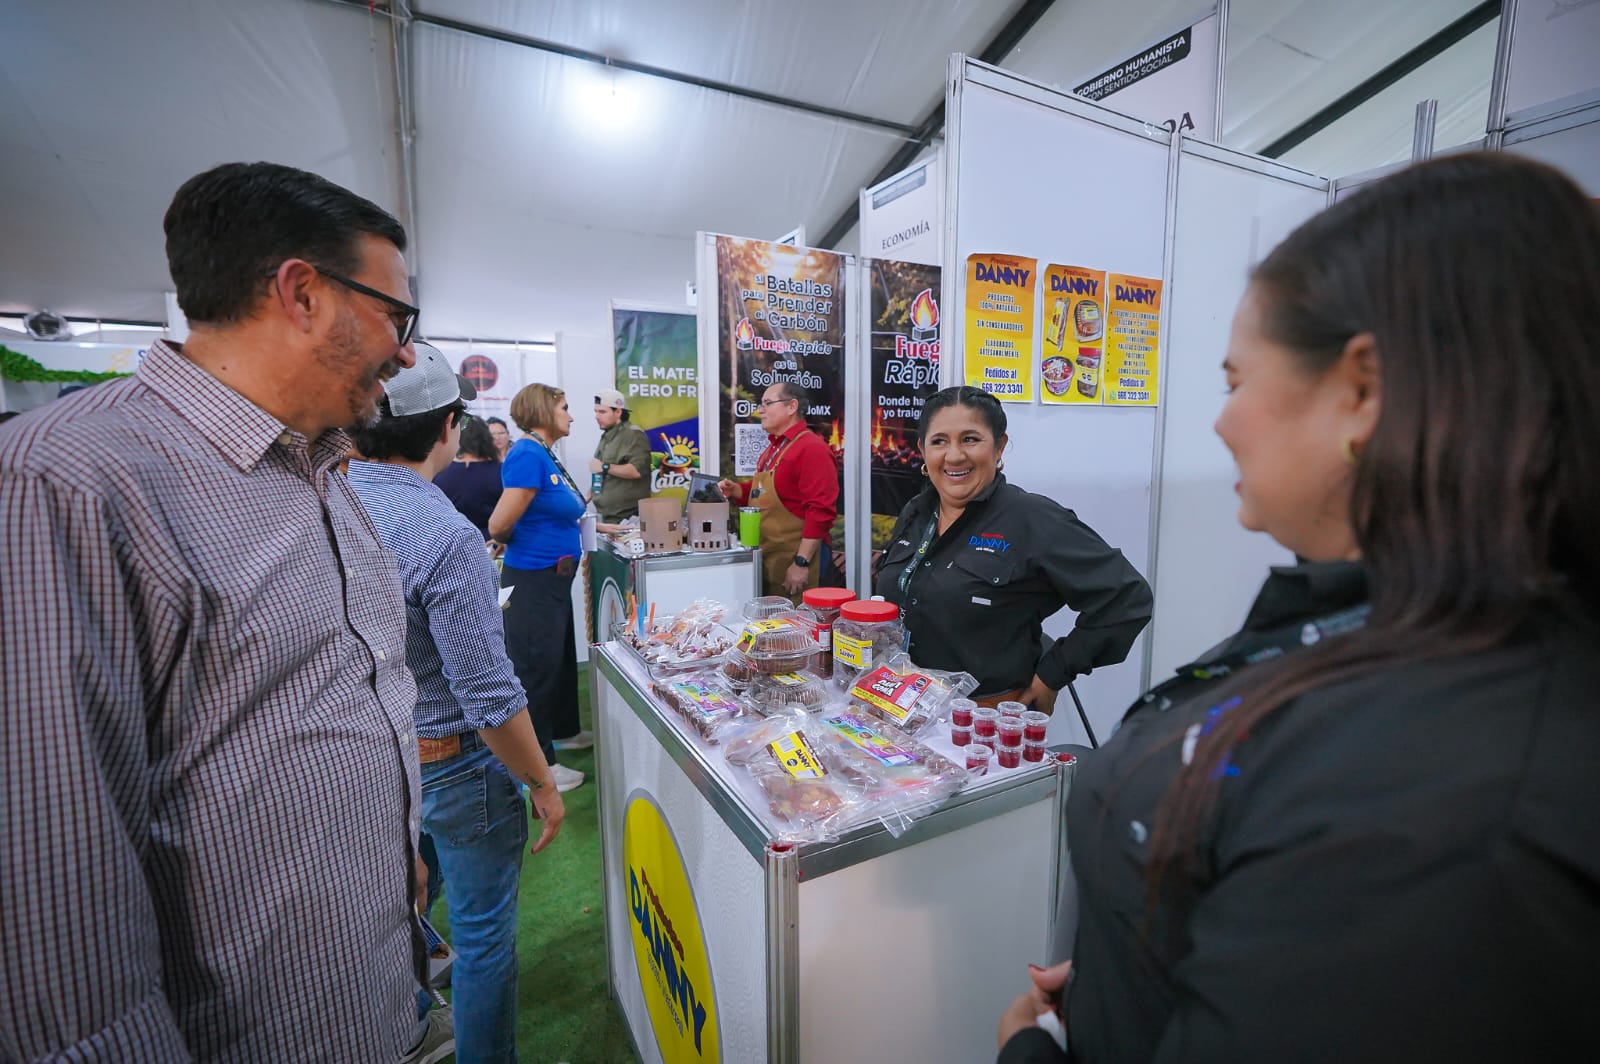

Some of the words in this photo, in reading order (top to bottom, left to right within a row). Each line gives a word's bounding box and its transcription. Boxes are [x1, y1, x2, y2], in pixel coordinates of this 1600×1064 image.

[1076, 68, 1124, 97] GOBIERNO
[1125, 36, 1186, 74] HUMANISTA
[1104, 71, 1140, 94] SENTIDO
[1140, 55, 1173, 76] SOCIAL
[882, 220, 930, 249] ECONOMÍA
[975, 262, 1030, 288] DANNY
[767, 275, 833, 296] Batallas
[1051, 274, 1099, 297] DANNY
[1115, 284, 1157, 306] DANNY
[767, 293, 832, 314] Prender
[768, 311, 828, 331] Carbón
[628, 366, 648, 379] EL
[774, 361, 786, 369] es
[787, 360, 798, 370] tu
[985, 367, 1009, 379] Pedidos
[1010, 369, 1017, 379] al
[629, 384, 673, 397] PERO
[994, 383, 1006, 393] 322
[1007, 384, 1023, 394] 3341
[879, 395, 910, 406] Donde
[883, 410, 895, 420] yo
[968, 535, 1011, 552] DANNY
[629, 864, 706, 1057] DANNY
